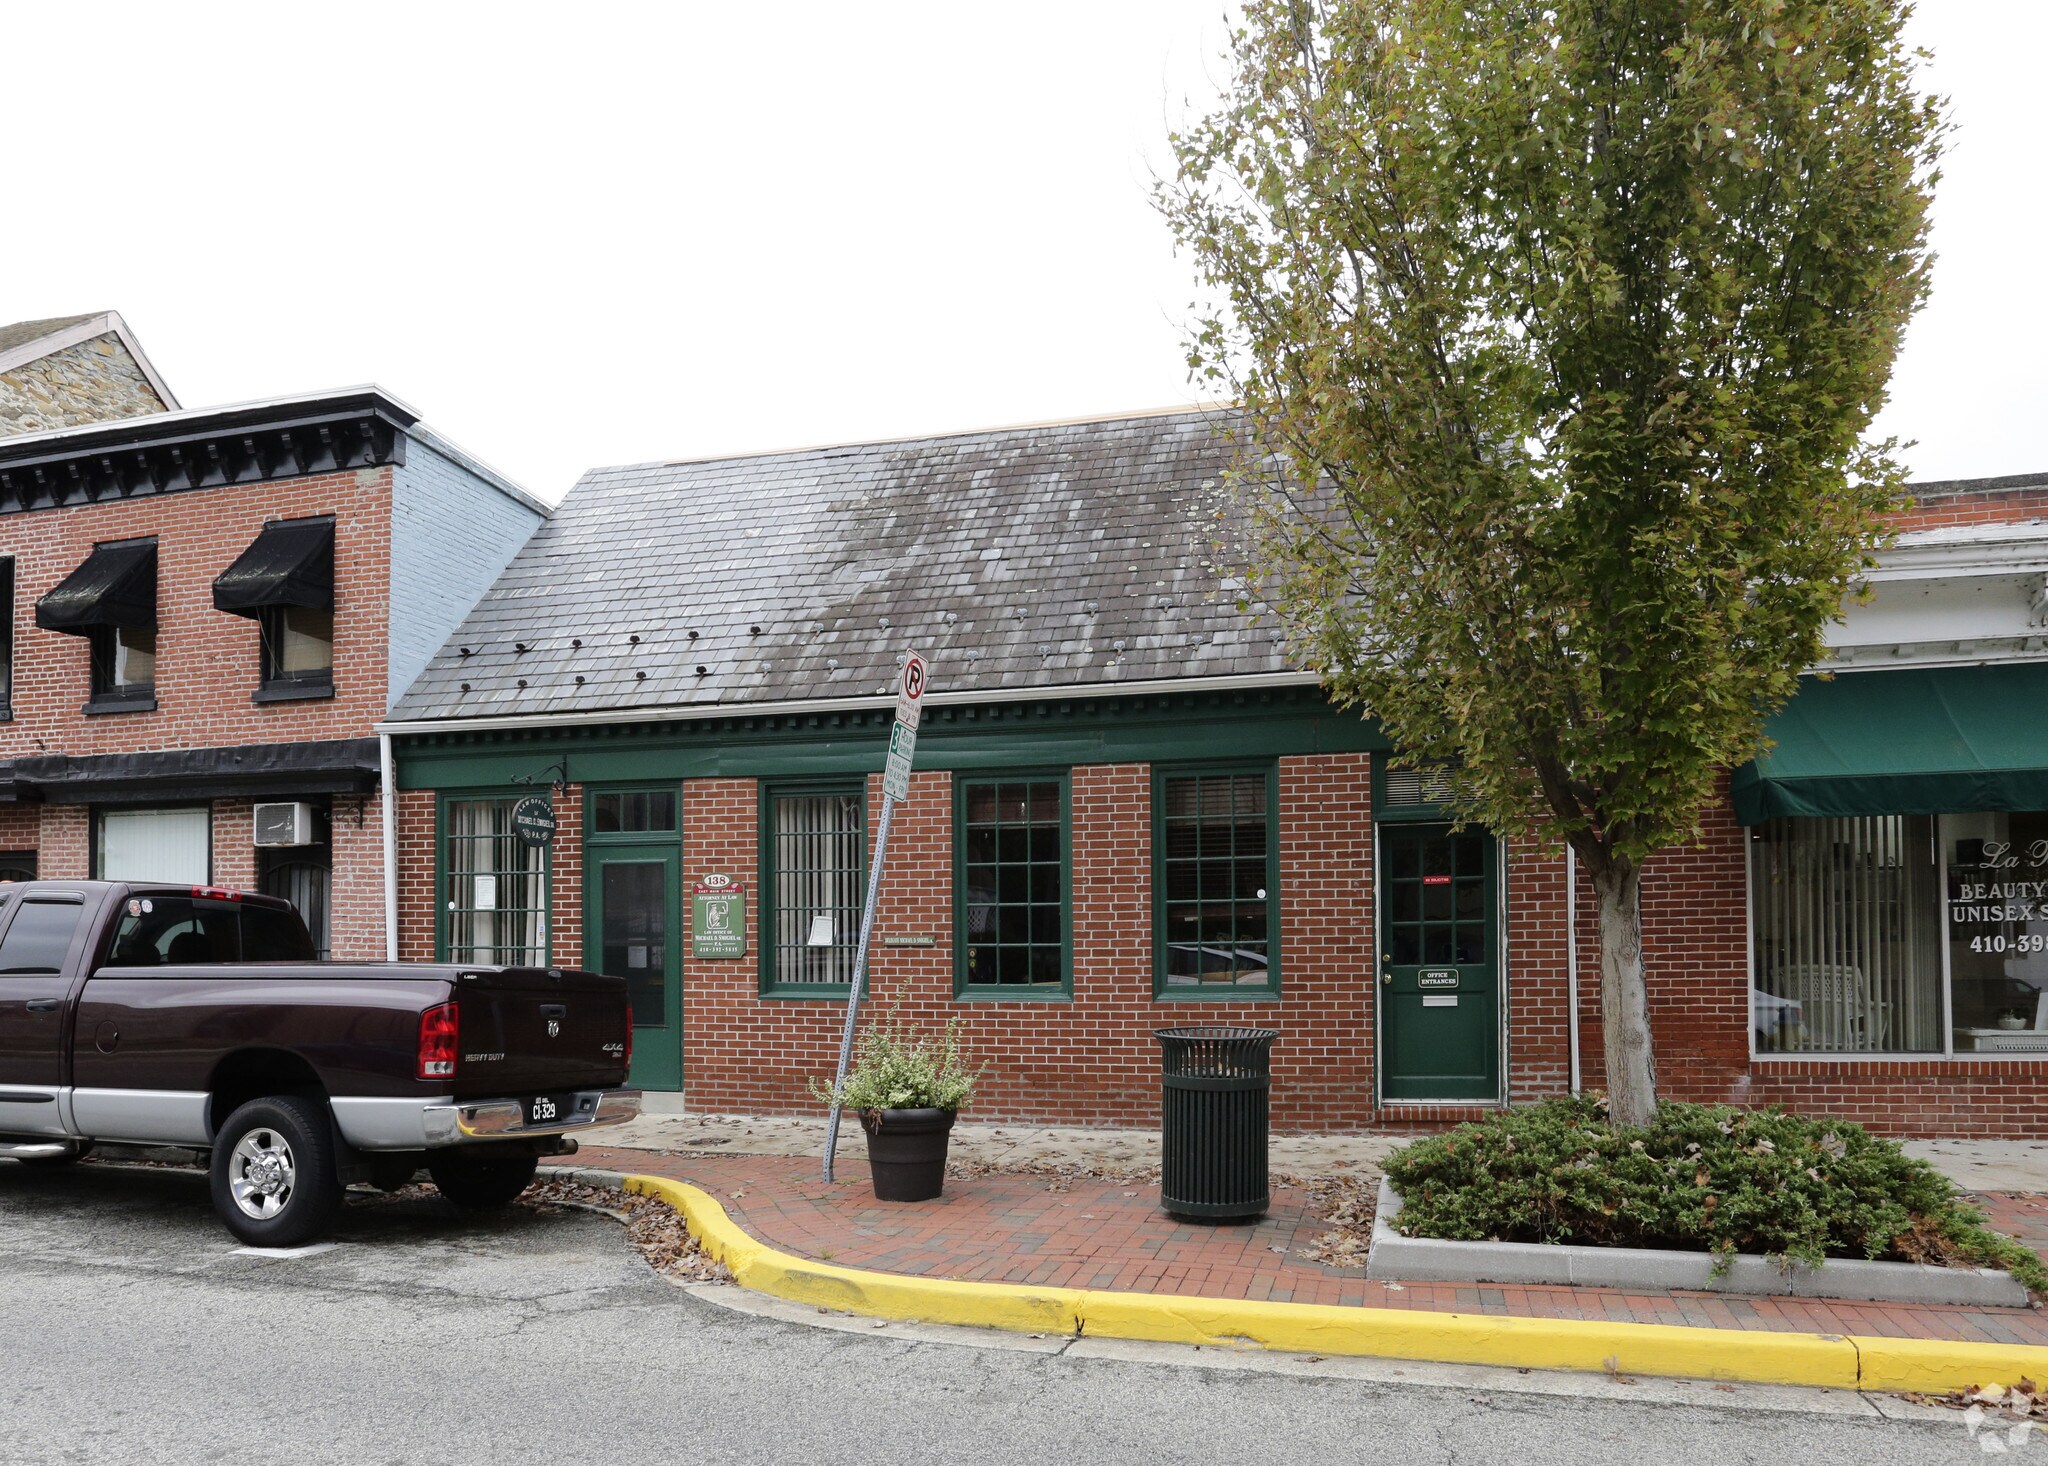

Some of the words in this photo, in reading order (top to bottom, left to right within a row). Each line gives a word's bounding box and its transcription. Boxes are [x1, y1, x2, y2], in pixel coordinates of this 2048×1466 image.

[892, 727, 900, 750] 3
[901, 734, 913, 745] HOUR
[518, 800, 530, 812] LAW
[531, 799, 554, 817] OFFICES
[1979, 842, 2020, 869] La
[707, 876, 726, 886] 138
[1960, 882, 2048, 900] BEAUTY
[1953, 904, 2034, 923] UNISEX
[1969, 935, 2048, 953] 410-39
[465, 1053, 488, 1062] HEAVY
[488, 1053, 505, 1061] DUTY
